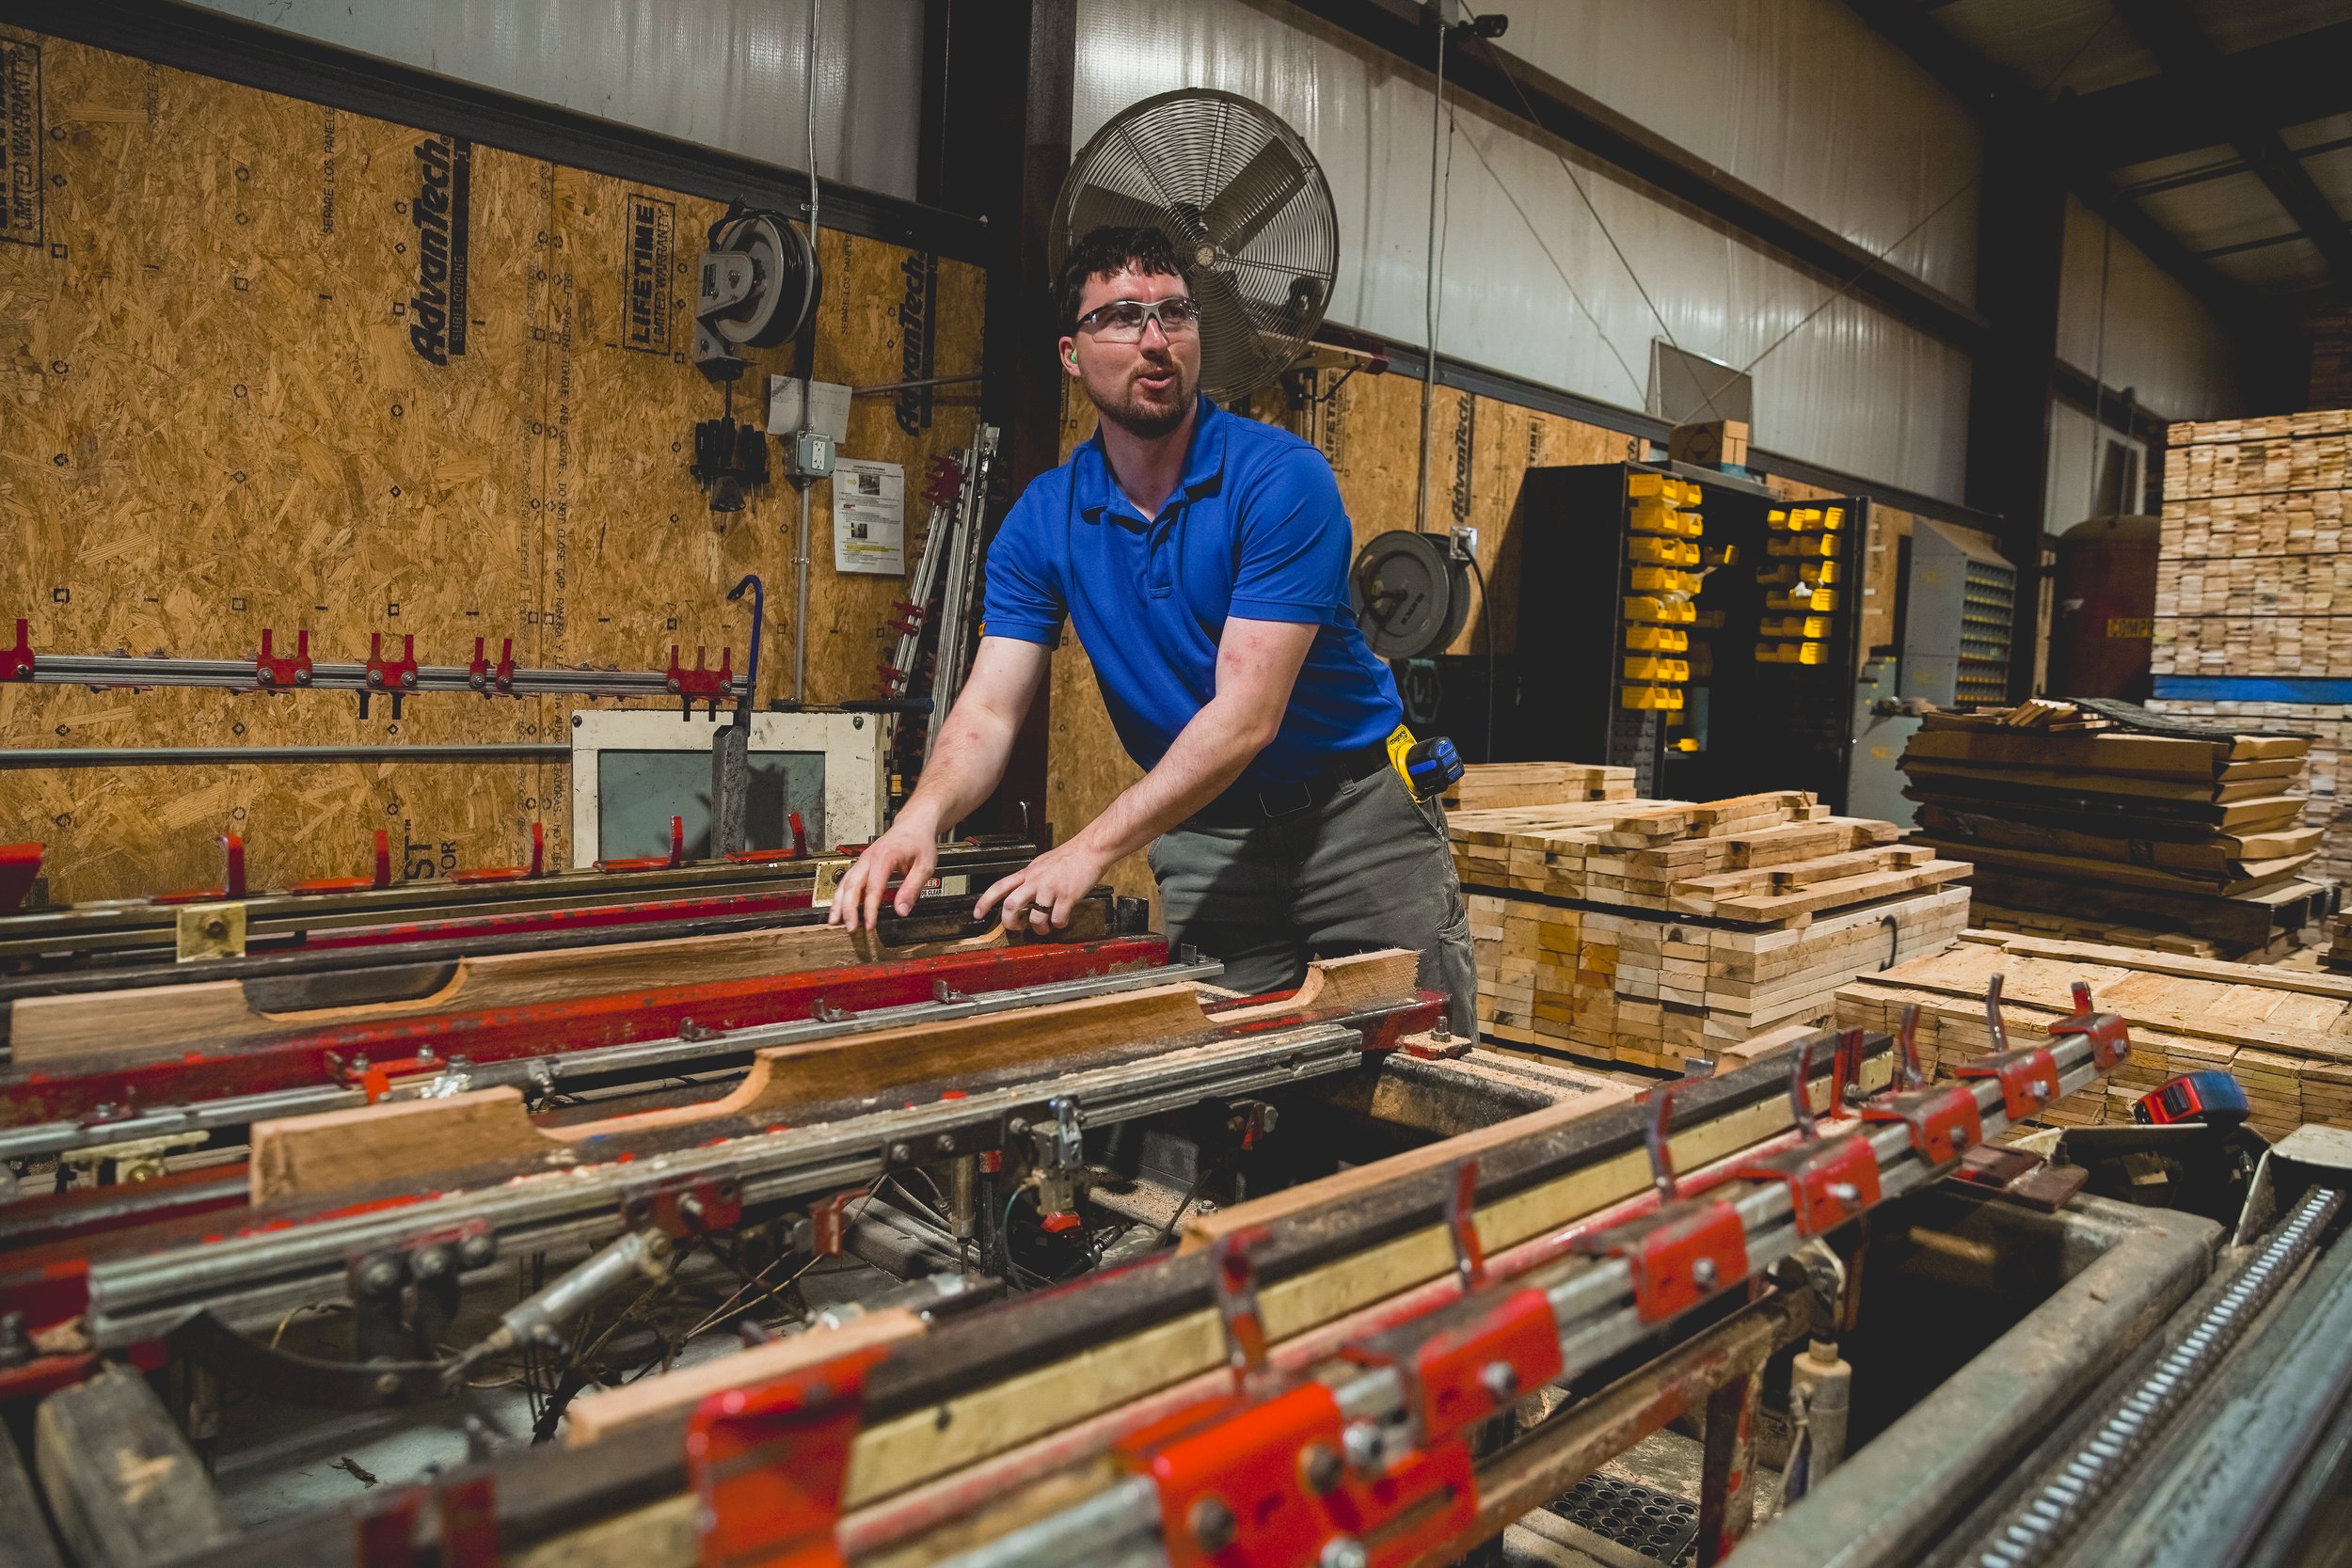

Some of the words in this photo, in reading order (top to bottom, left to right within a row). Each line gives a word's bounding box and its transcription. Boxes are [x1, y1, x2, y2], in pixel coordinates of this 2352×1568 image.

[10, 48, 31, 156] WARRANTY
[12, 161, 32, 230] LIMITED
[324, 157, 335, 183] LOS
[323, 185, 334, 233] SEPARE
[631, 202, 654, 344] LIFETIME
[655, 207, 668, 289] WARRANTY
[452, 254, 465, 341] SUBFLOORING
[653, 289, 665, 344] LIMITED
[840, 297, 849, 336] SEPARE
[1528, 421, 1536, 464] TIME
[555, 529, 565, 562] CLOSE
